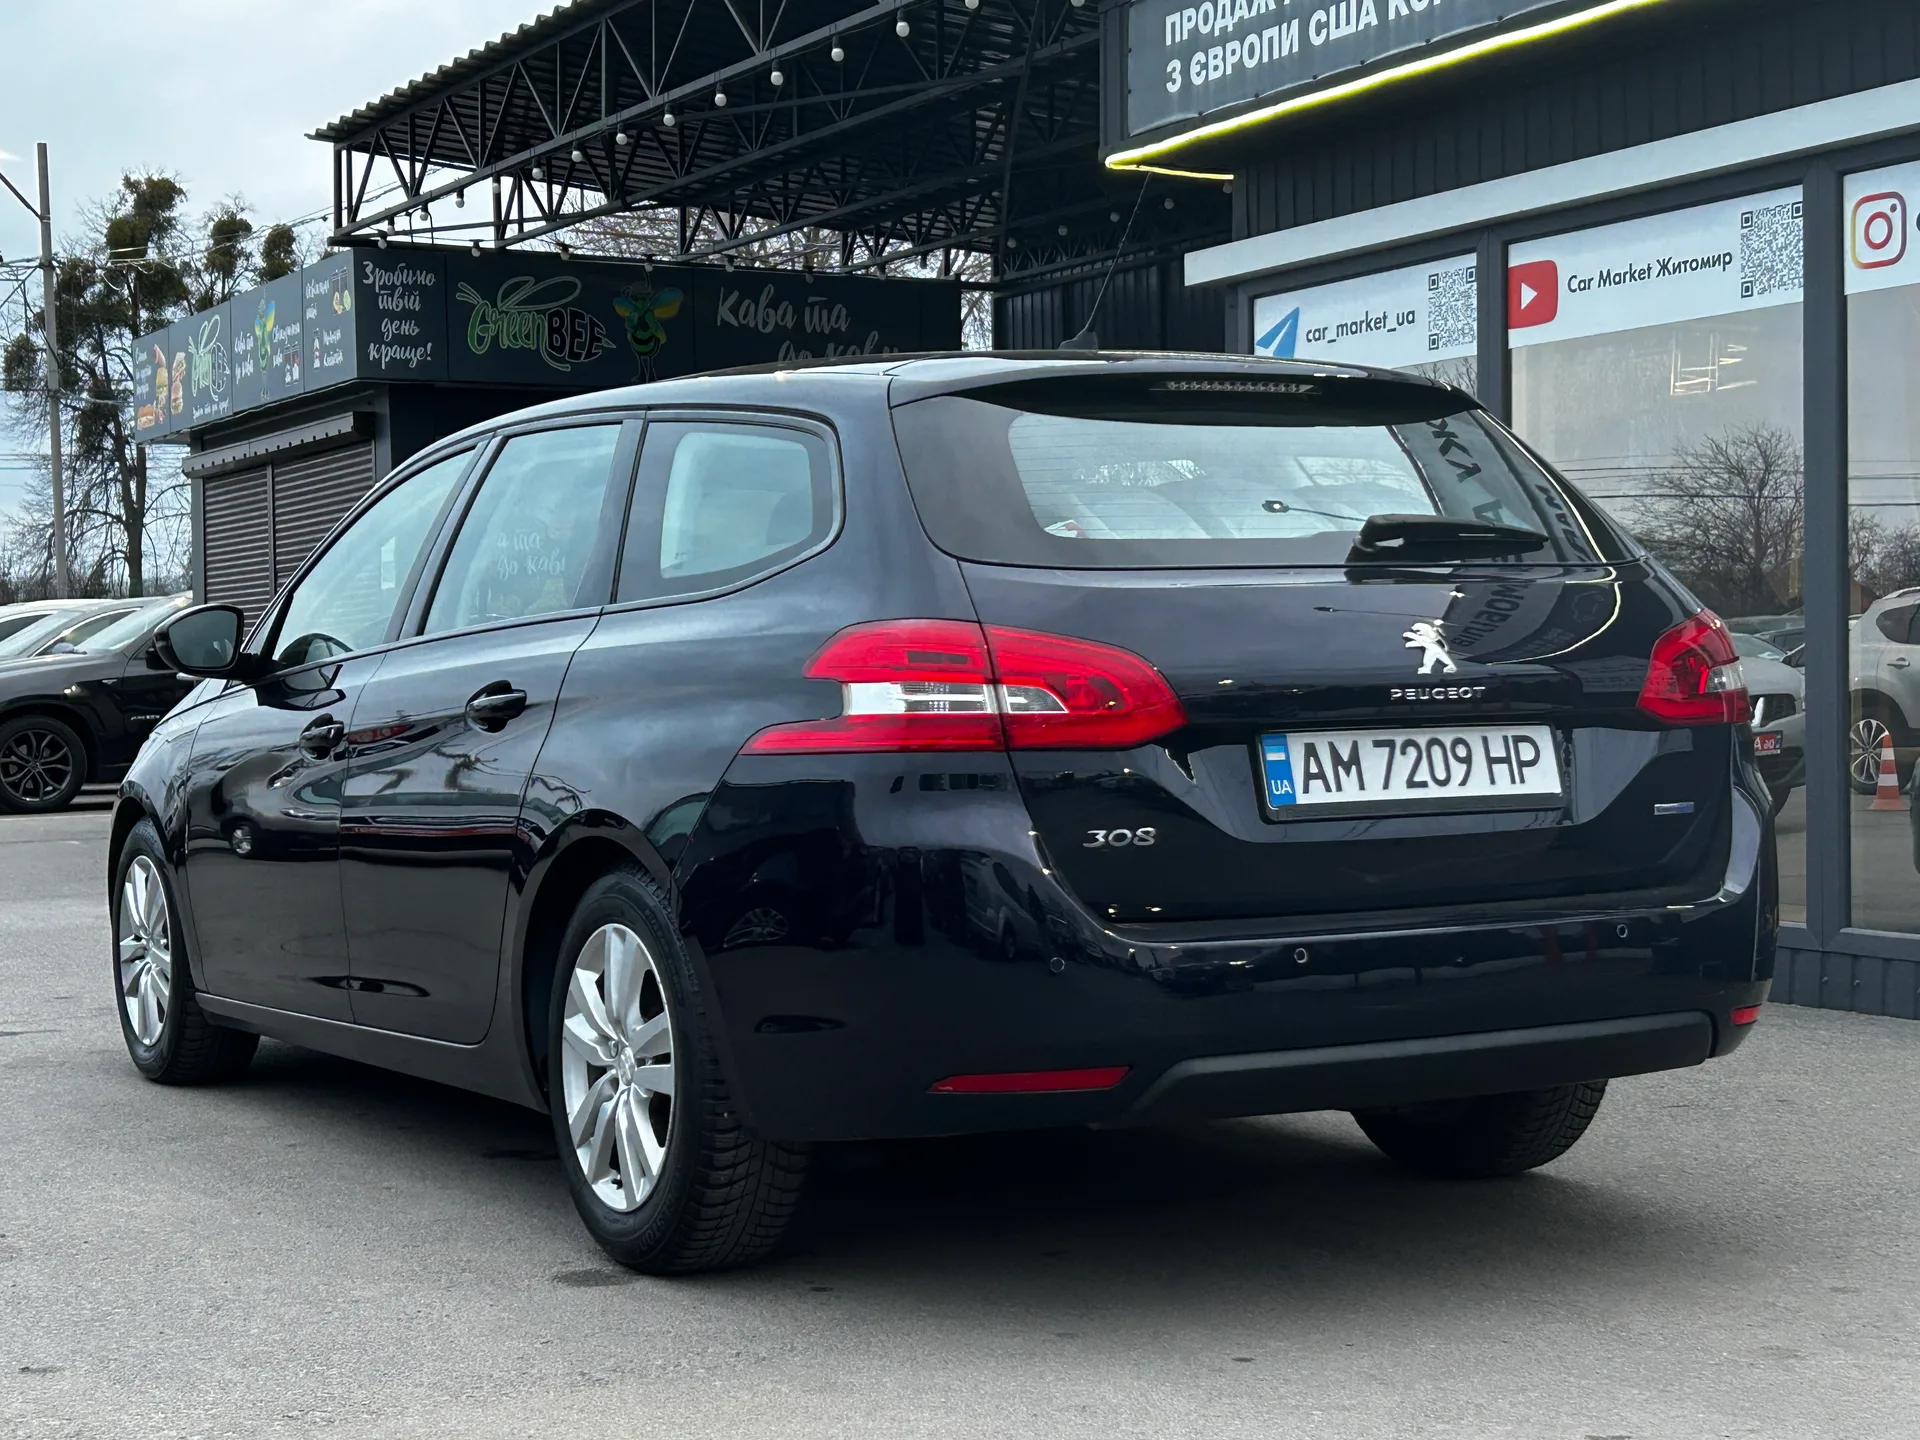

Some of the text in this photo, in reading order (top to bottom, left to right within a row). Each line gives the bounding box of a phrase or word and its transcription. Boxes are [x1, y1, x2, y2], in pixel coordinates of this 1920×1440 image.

[1166, 59, 1182, 93] З
[1189, 18, 1299, 86] ЄВРОПИ
[1308, 0, 1379, 46] США
[362, 261, 436, 293] Зробимо
[1567, 251, 1734, 293] Car Market Житомир
[378, 286, 421, 312] твій
[717, 284, 851, 335] Кава та
[381, 318, 420, 342] день
[1305, 310, 1416, 344] car_market_ua
[367, 342, 432, 369] краще!
[1390, 686, 1487, 700] PEUGEOT
[1302, 734, 1541, 795] AM 7209 HP
[1271, 779, 1293, 795] UA
[1083, 827, 1157, 848] 308
